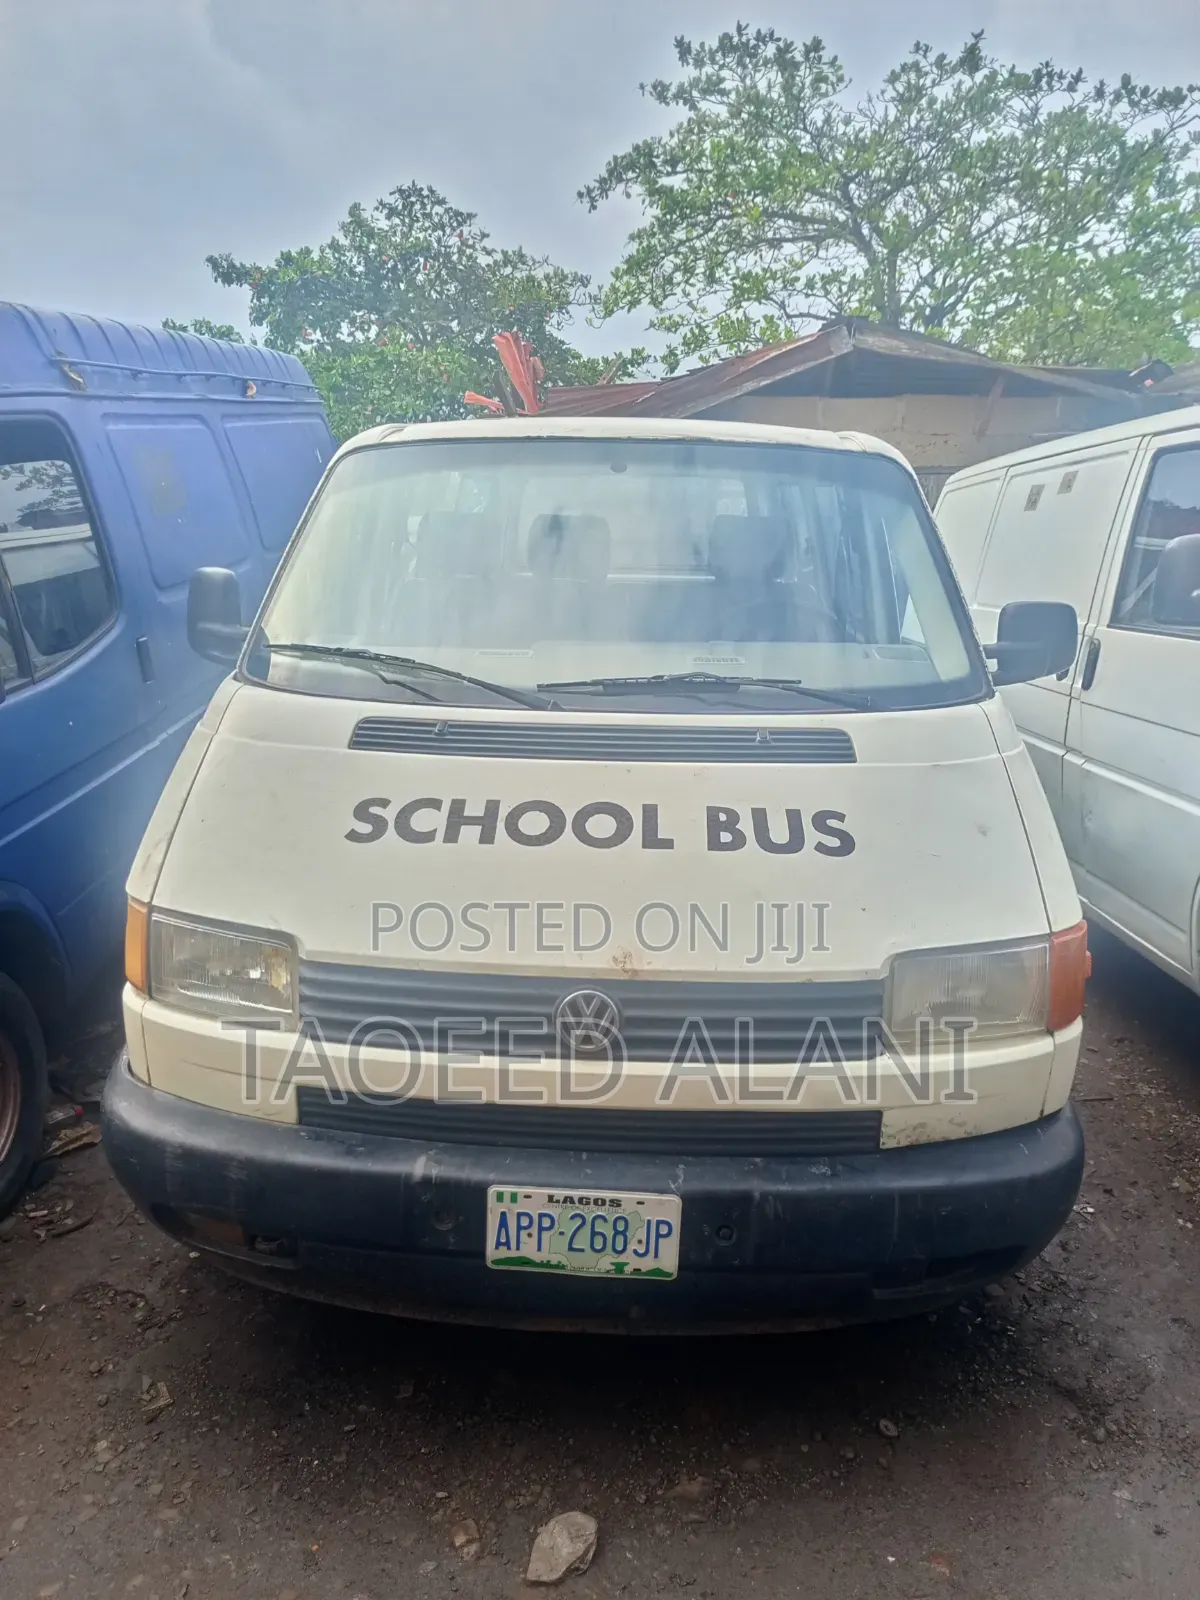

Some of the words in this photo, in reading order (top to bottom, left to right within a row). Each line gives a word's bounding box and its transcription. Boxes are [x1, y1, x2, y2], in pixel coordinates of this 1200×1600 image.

[344, 796, 675, 850] SCHOOL
[706, 805, 857, 858] BUS
[546, 1194, 623, 1208] LAGOS
